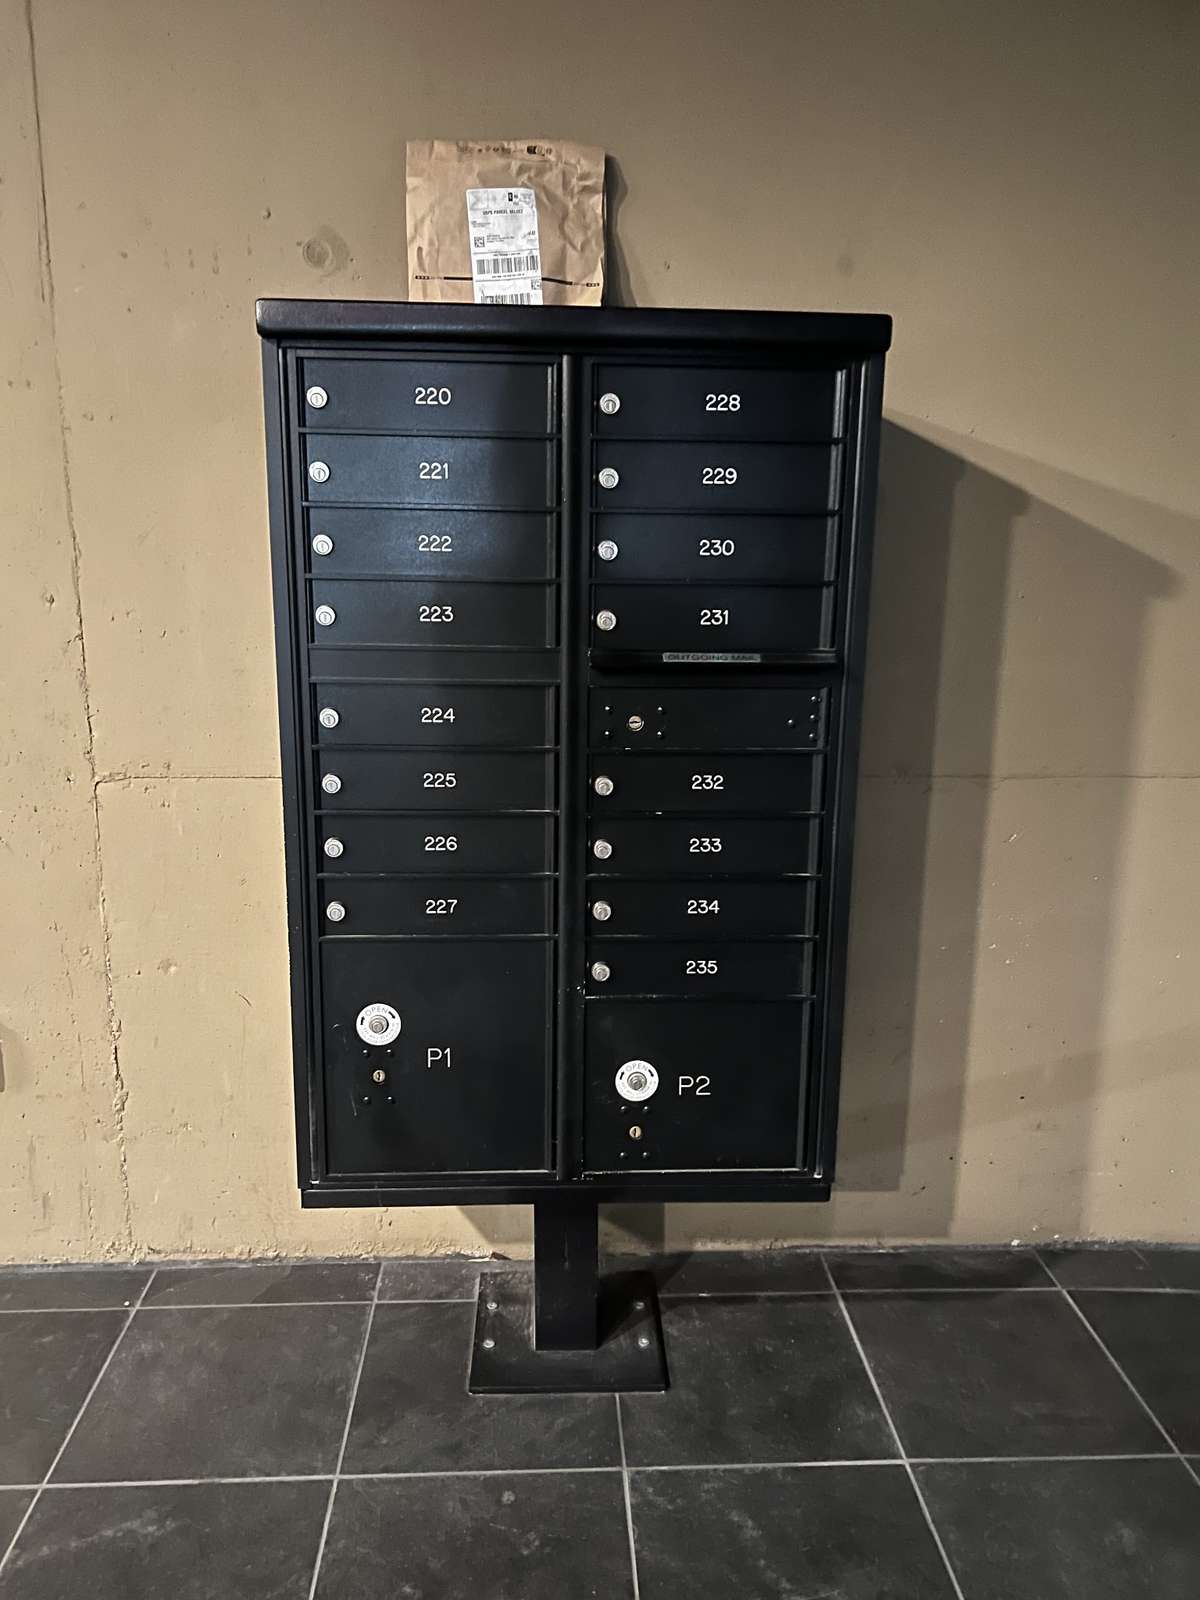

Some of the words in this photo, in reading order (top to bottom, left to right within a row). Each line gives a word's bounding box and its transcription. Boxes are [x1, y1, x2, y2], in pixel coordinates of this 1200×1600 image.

[414, 387, 452, 405] 220
[705, 394, 741, 412] 228
[419, 462, 449, 480] 221
[702, 467, 738, 485] 229
[418, 534, 453, 552] 222
[699, 539, 735, 556] 230
[419, 605, 454, 622] 223
[700, 609, 729, 626] 231
[421, 707, 456, 723] 224
[423, 772, 457, 788] 225
[691, 774, 724, 790] 232
[424, 836, 458, 851] 226
[689, 837, 722, 853] 233
[425, 899, 458, 914] 227
[687, 899, 720, 914] 234
[686, 960, 718, 975] 235
[365, 1005, 388, 1016] OPEN
[427, 1047, 451, 1068] P1
[625, 1062, 648, 1072] OPEN
[678, 1075, 712, 1096] P2
